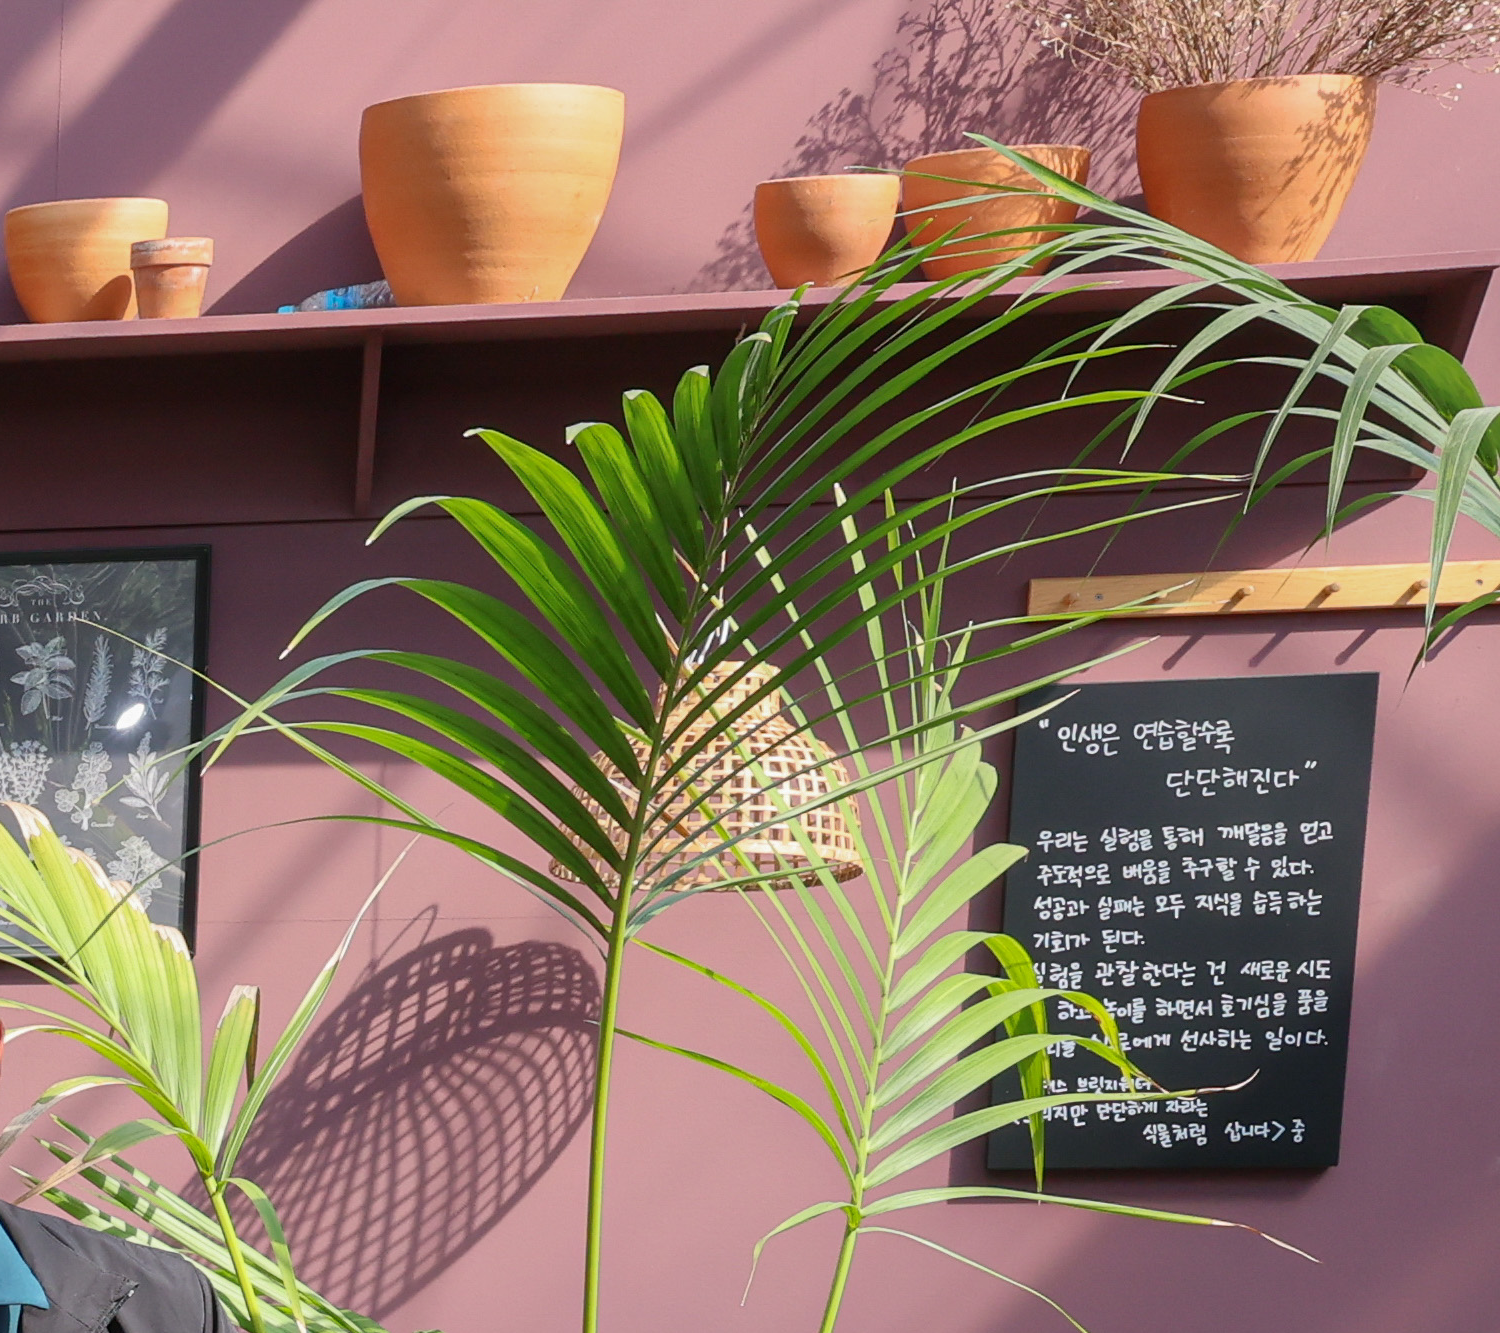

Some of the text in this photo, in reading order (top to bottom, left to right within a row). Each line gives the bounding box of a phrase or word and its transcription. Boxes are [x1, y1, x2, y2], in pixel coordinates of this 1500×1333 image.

[1133, 719, 1235, 754] 연습할수록
[1037, 821, 1334, 854] 우리는 실험을 통해 깨달음을 얻고
[1037, 856, 1315, 887] 주도적으로 배움을 추구할 수 있다.
[1033, 895, 1090, 920] 성공과
[1097, 895, 1145, 920] 실패는
[1156, 894, 1186, 919] 모두
[1195, 892, 1242, 917] 지식을
[1033, 929, 1145, 954] 기회가 된다.
[1206, 957, 1332, 986] 건 새로운 시도
[1156, 989, 1329, 1019] 하면서 호기심을 품을
[1181, 1030, 1252, 1051] 선사하는
[1096, 1099, 1209, 1122] 단단하게 자라는
[1143, 1125, 1209, 1148] 식물처럼
[1291, 1119, 1305, 1144] 중
